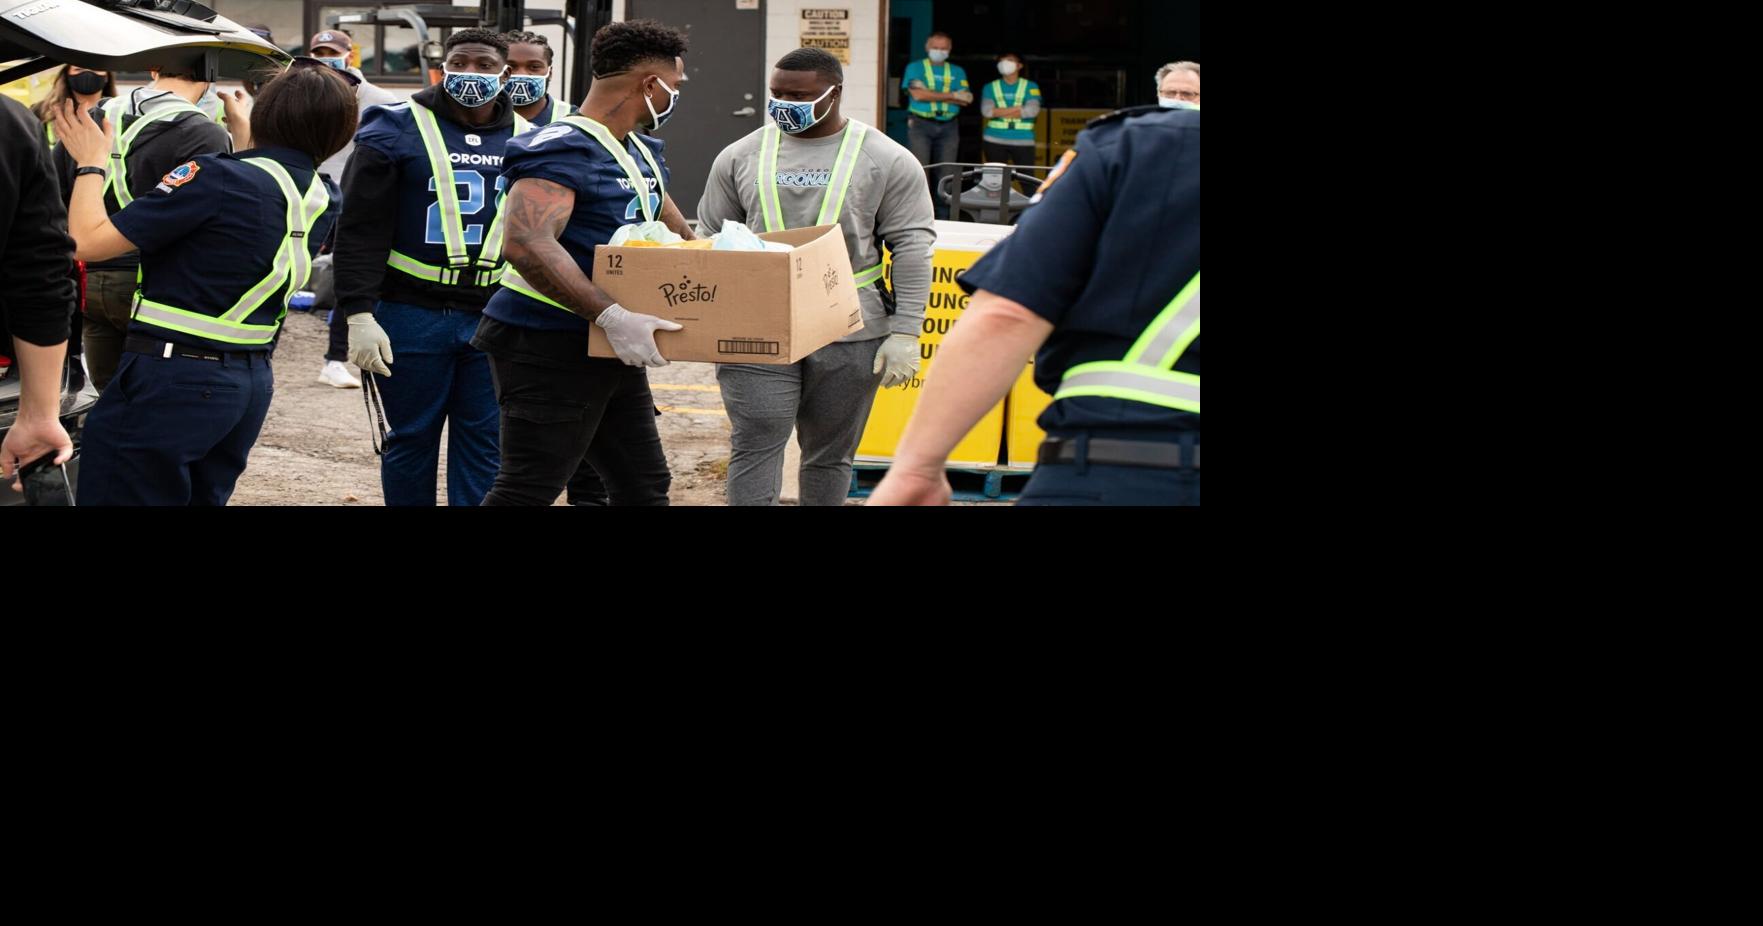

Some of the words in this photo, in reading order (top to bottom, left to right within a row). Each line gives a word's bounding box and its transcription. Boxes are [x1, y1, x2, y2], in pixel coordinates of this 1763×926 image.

[804, 10, 845, 19] CAUTION
[803, 39, 848, 48] CAUTION
[449, 152, 504, 166] ORONT
[615, 177, 657, 190] TOTO
[607, 254, 623, 268] 12
[658, 281, 717, 307] Presto!
